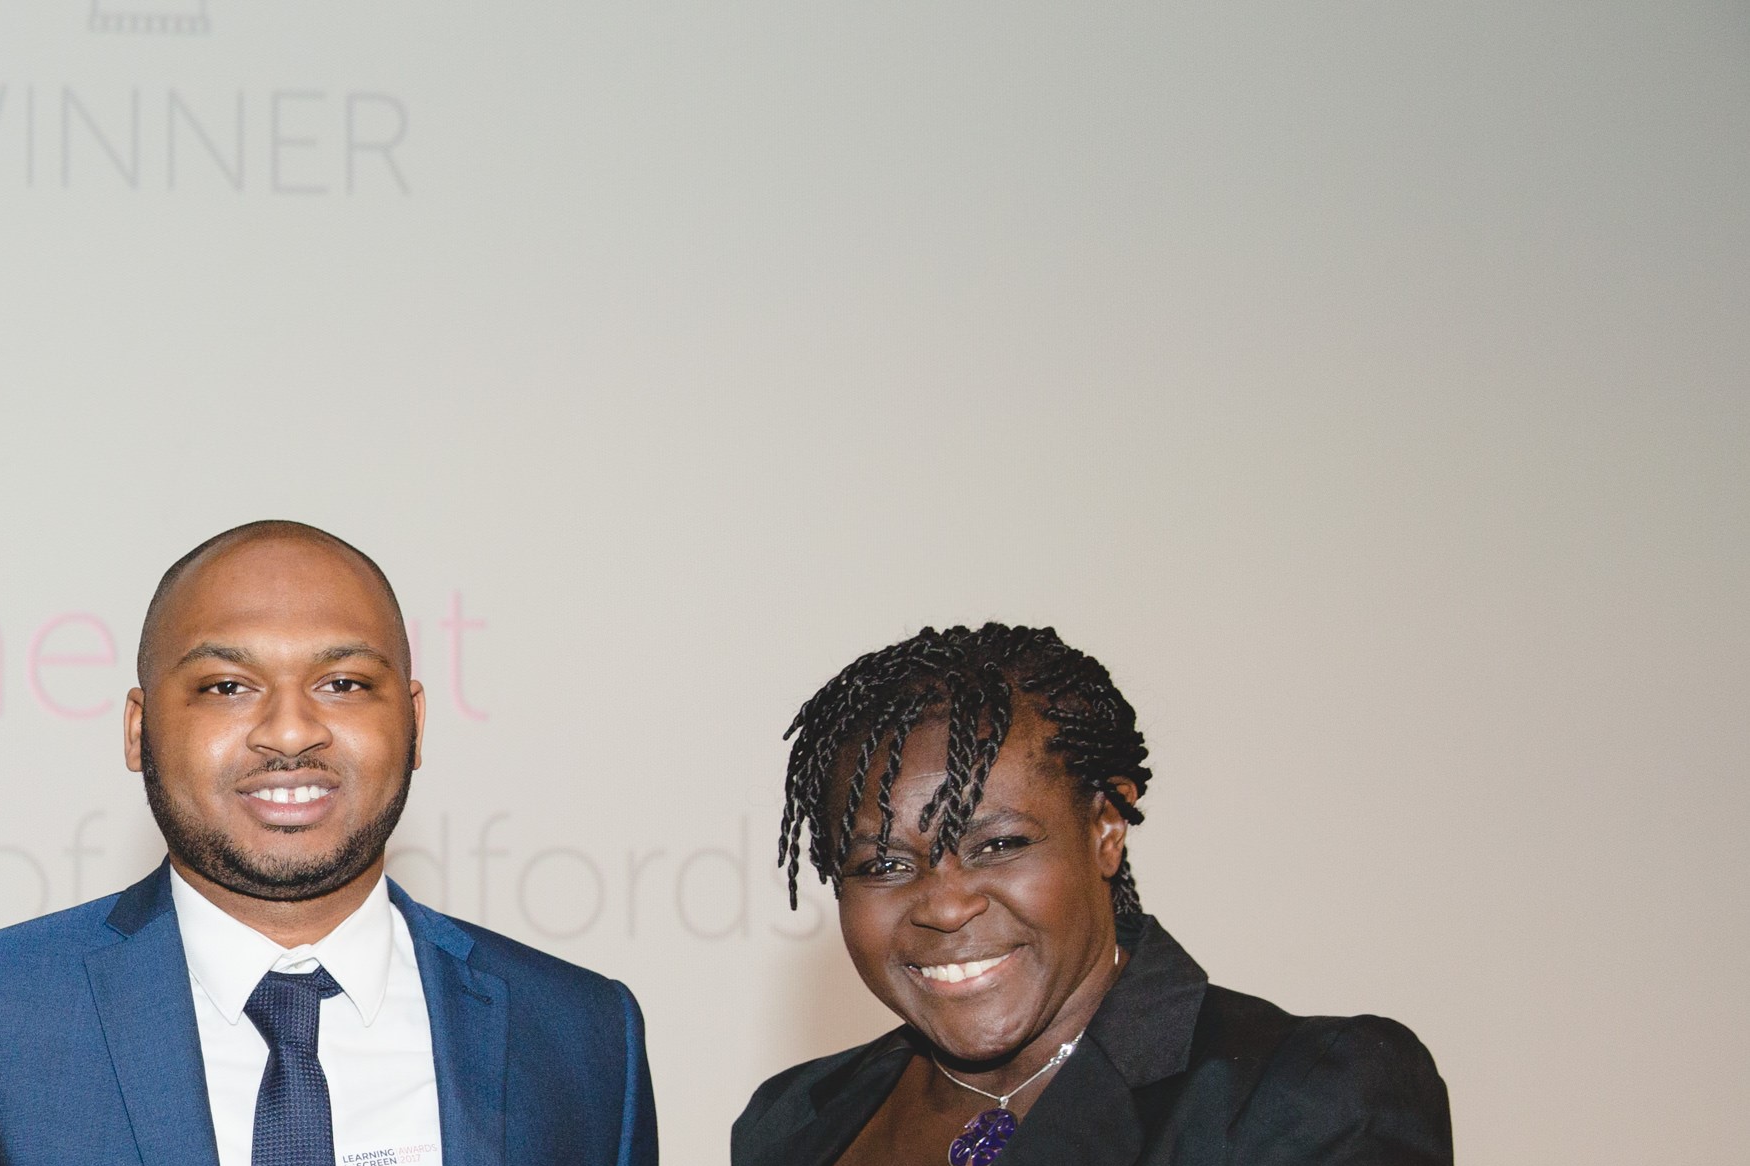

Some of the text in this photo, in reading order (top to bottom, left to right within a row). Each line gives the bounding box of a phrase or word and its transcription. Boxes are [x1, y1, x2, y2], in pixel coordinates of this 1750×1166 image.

[343, 1143, 438, 1163] LEARNING AWARDS
[400, 1154, 421, 1164] 2017
